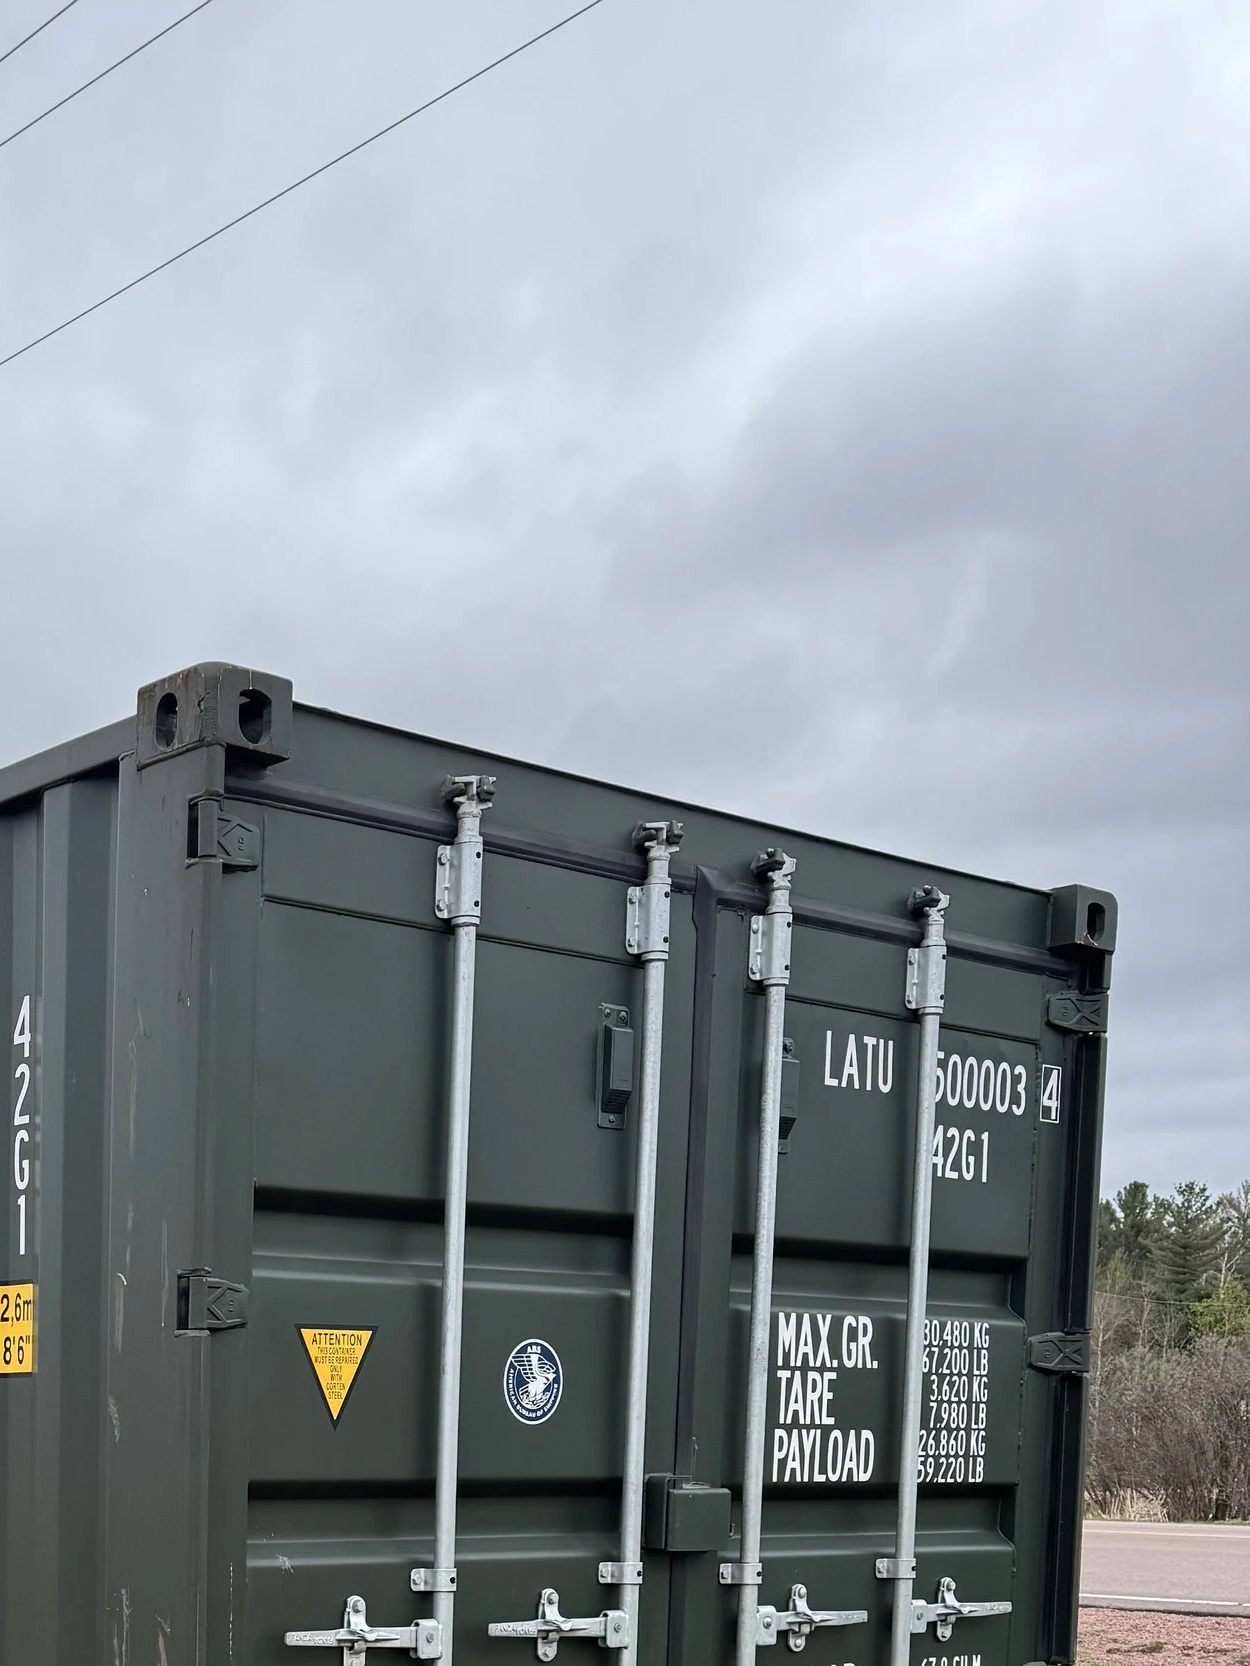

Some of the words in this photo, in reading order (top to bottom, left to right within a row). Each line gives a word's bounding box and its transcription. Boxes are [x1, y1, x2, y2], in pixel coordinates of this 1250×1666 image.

[824, 1030, 894, 1094] LATU
[1041, 1067, 1060, 1121] 4
[13, 994, 31, 1256] 42G1
[931, 1124, 990, 1184] 42G1
[0, 1293, 33, 1328] 2,6m
[311, 1332, 362, 1346] ATTENTION
[776, 1311, 839, 1368] MAX.
[841, 1315, 879, 1369] GR.
[923, 1319, 970, 1347] 30,480
[973, 1321, 990, 1349] KG
[3, 1335, 31, 1365] 8'6"
[314, 1356, 328, 1364] MUST
[328, 1356, 335, 1364] BE
[335, 1356, 359, 1365] REPAIRED
[317, 1346, 328, 1355] THIS
[329, 1347, 356, 1356] CONTAINER
[526, 1345, 542, 1354] ABS
[921, 1347, 969, 1375] 67,200
[972, 1349, 989, 1376] LB
[329, 1365, 343, 1373] ONLY
[330, 1373, 343, 1382] WITH
[326, 1382, 346, 1391] CORTEN
[328, 1391, 343, 1400] STEEL
[777, 1370, 837, 1425] TARE
[930, 1375, 968, 1402] 3,620
[972, 1376, 988, 1402] KG
[929, 1402, 967, 1429] 7,980
[971, 1403, 987, 1429] LB
[771, 1428, 875, 1482] PAYLOAD
[918, 1429, 966, 1456] 26,860
[969, 1431, 986, 1457] KG
[917, 1456, 965, 1483] 59,220
[968, 1457, 984, 1483] LB
